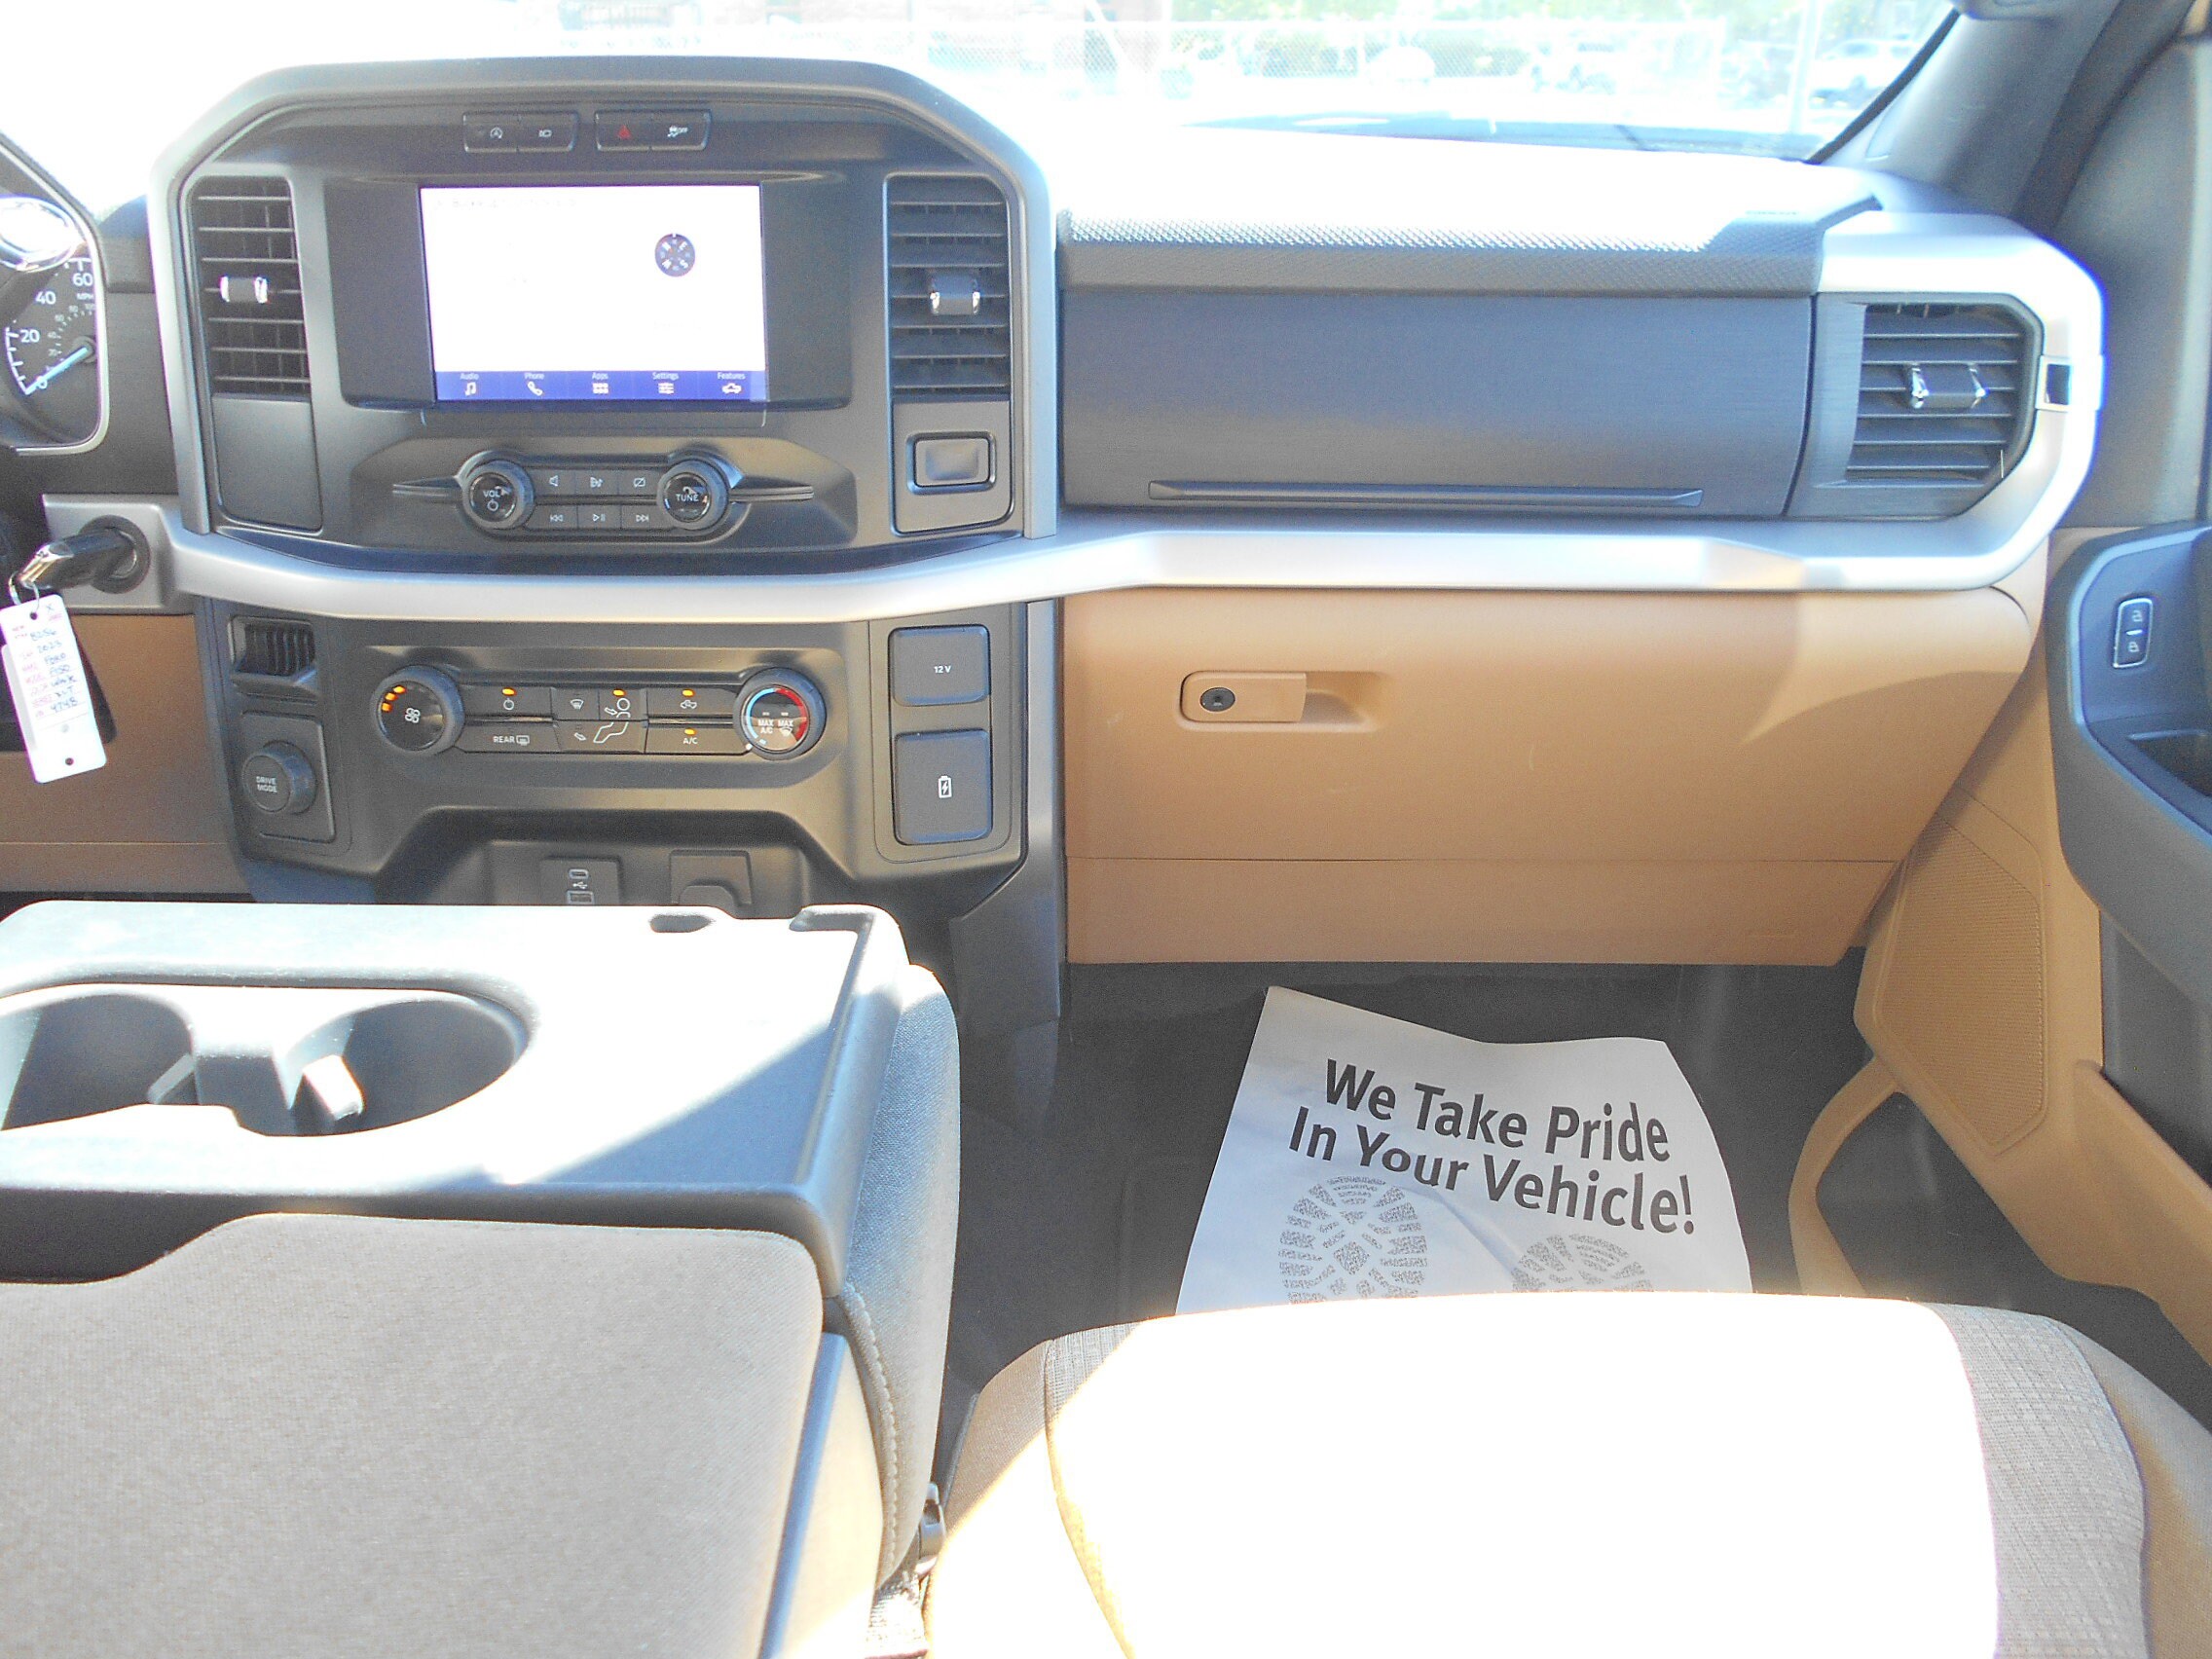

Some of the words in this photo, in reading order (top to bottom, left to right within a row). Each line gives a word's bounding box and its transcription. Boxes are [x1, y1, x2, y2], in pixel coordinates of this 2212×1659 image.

[680, 259, 688, 269] S
[72, 272, 92, 286] 60
[35, 290, 56, 305] 40
[20, 329, 40, 343] 20
[592, 372, 608, 381] Apps
[652, 372, 679, 381] Settings
[493, 735, 515, 744] REAR
[682, 736, 699, 745] A/C
[256, 776, 276, 785] DRIVE
[257, 784, 277, 793] MODE
[1325, 1057, 1397, 1121] We
[1414, 1082, 1529, 1149] Take
[1544, 1101, 1671, 1162] Pride
[1288, 1106, 1338, 1161] In
[1357, 1124, 1471, 1192] Your
[1483, 1153, 1695, 1235] Vehicle!
